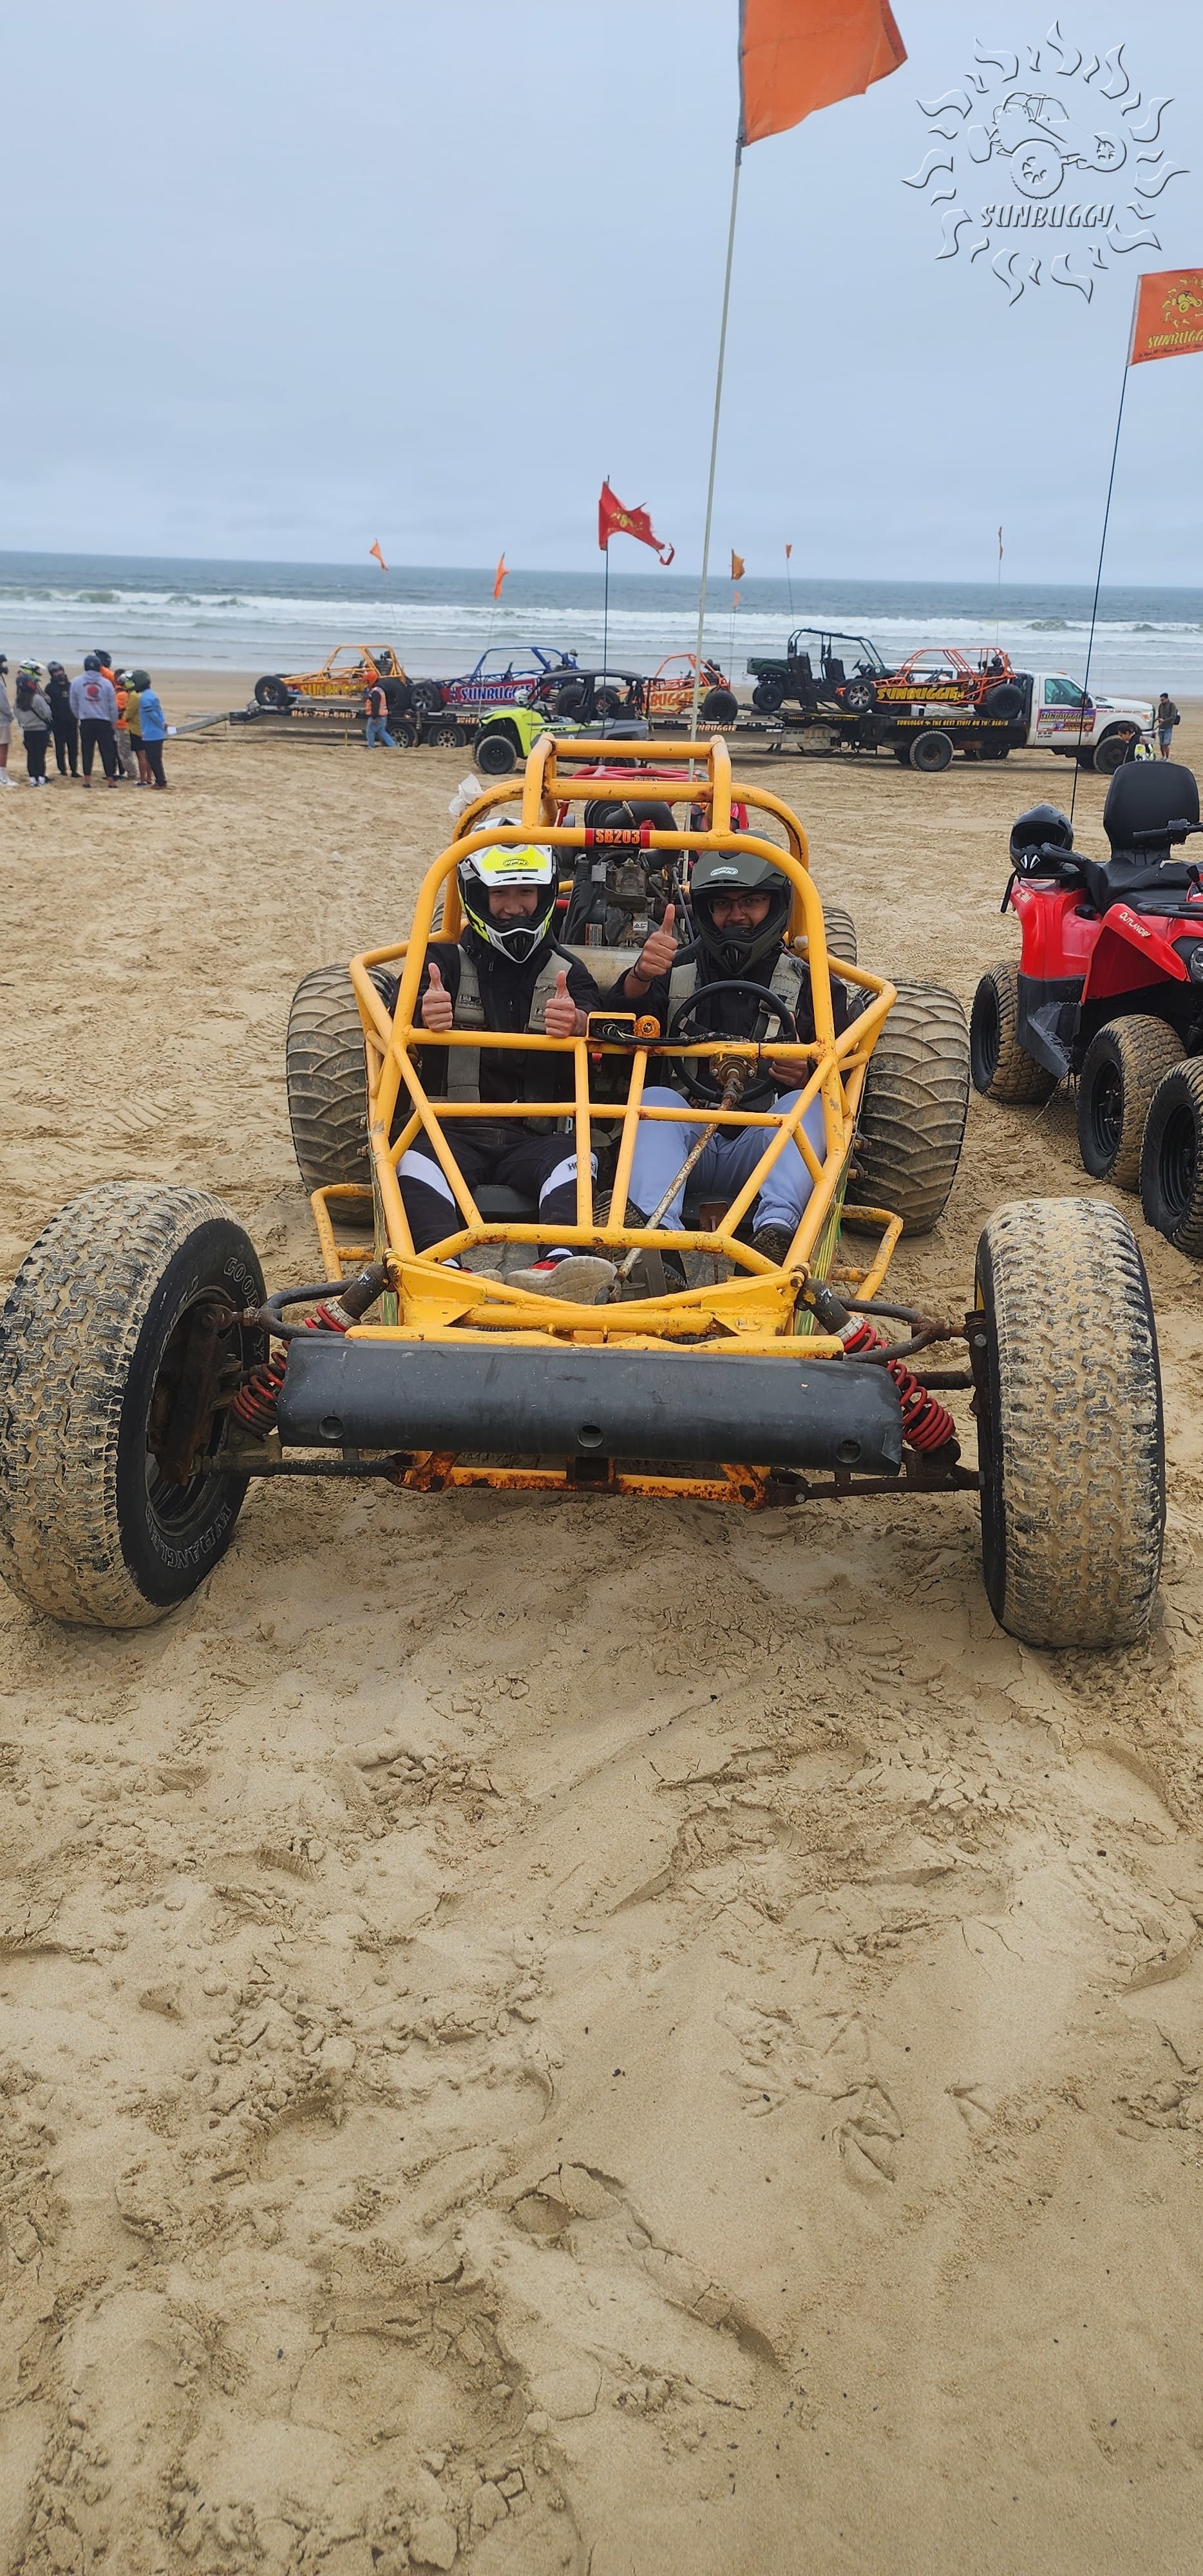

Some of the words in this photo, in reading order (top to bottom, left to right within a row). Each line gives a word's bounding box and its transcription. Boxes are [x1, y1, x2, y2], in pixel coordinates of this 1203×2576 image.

[1148, 329, 1203, 348] SUNBUGG
[460, 684, 533, 701] SUNBUGE
[595, 829, 640, 844] SB203
